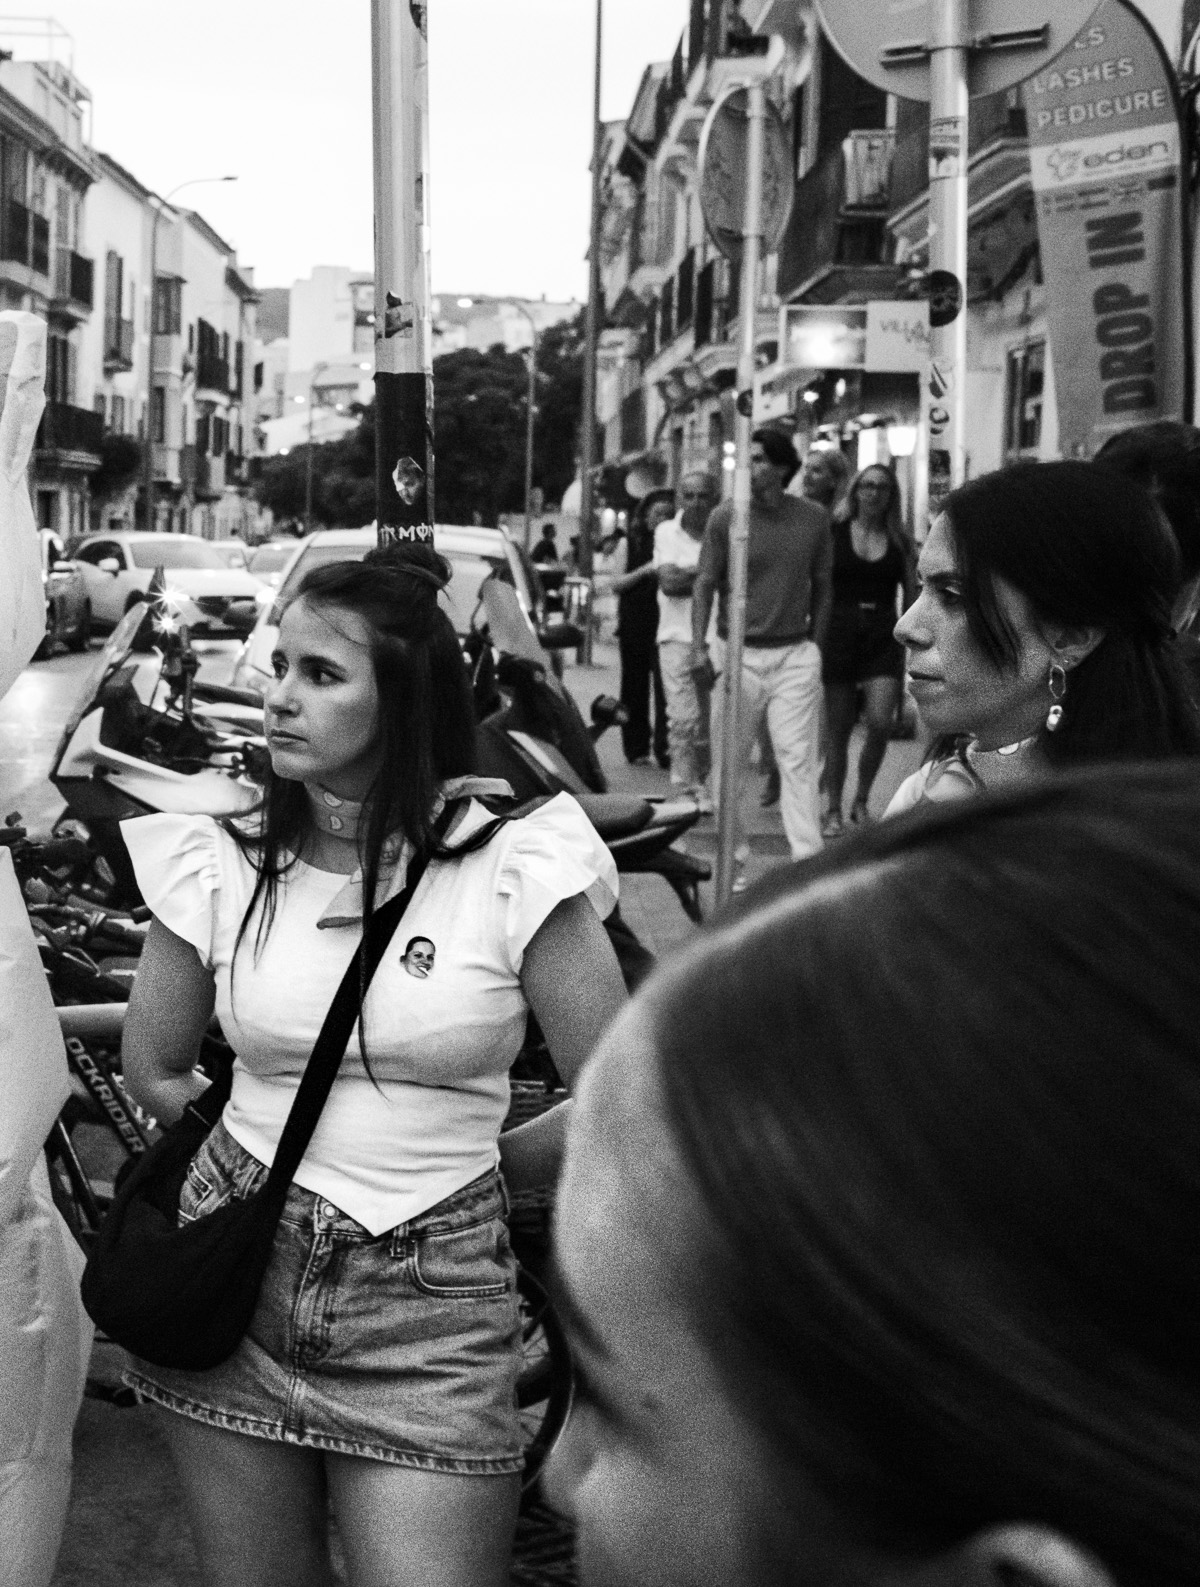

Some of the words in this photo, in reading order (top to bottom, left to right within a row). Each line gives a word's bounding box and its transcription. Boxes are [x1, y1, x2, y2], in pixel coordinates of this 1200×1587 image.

[1033, 57, 1134, 94] LASHES
[1037, 88, 1166, 128] PEDICURE
[1083, 141, 1169, 168] eden
[1085, 211, 1145, 269] IN
[1093, 283, 1156, 415] DROP
[66, 1036, 147, 1152] OCKRIDER
